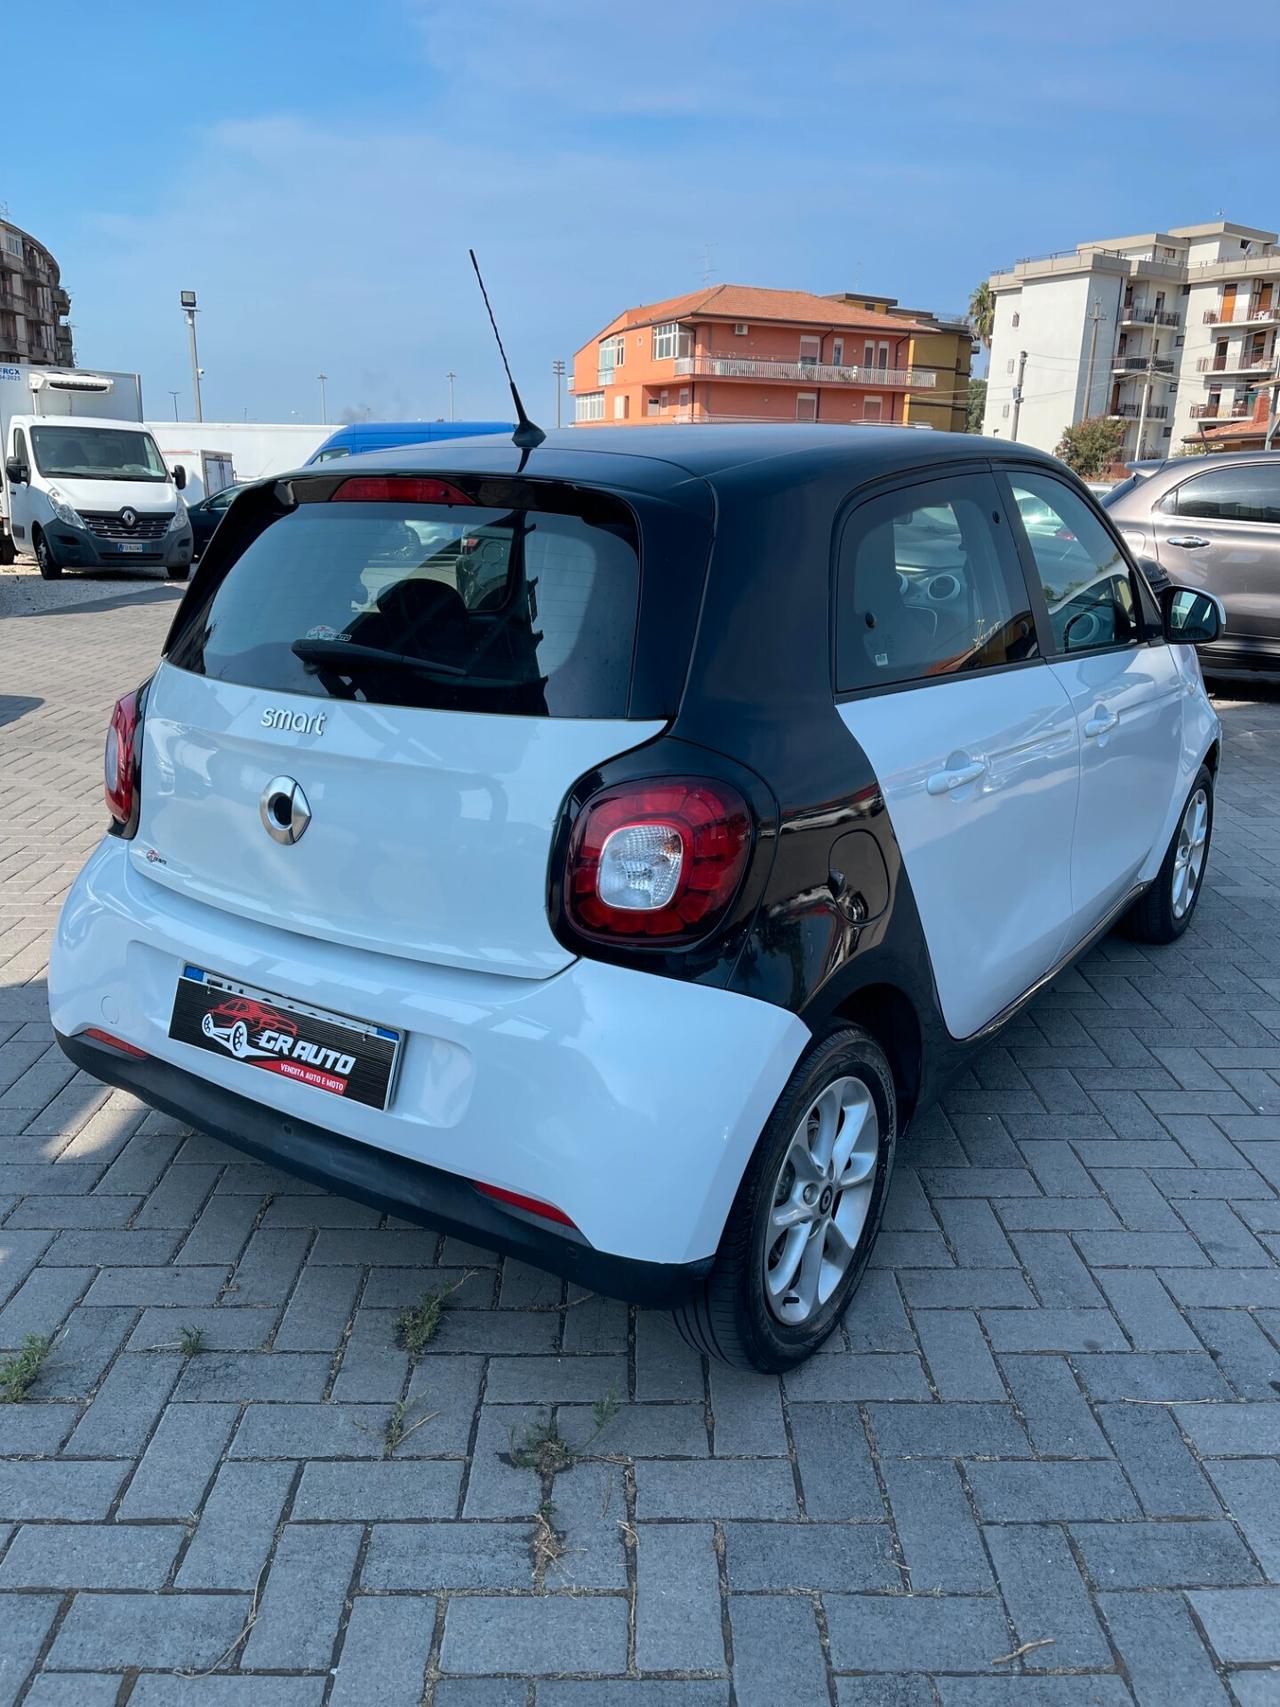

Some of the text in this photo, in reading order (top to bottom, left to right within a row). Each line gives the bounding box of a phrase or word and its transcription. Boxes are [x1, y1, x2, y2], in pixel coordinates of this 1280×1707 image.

[261, 708, 327, 736] smart
[258, 1030, 356, 1075] GR AUTO
[280, 1063, 344, 1091] VENDITA AUTO E MOTO
